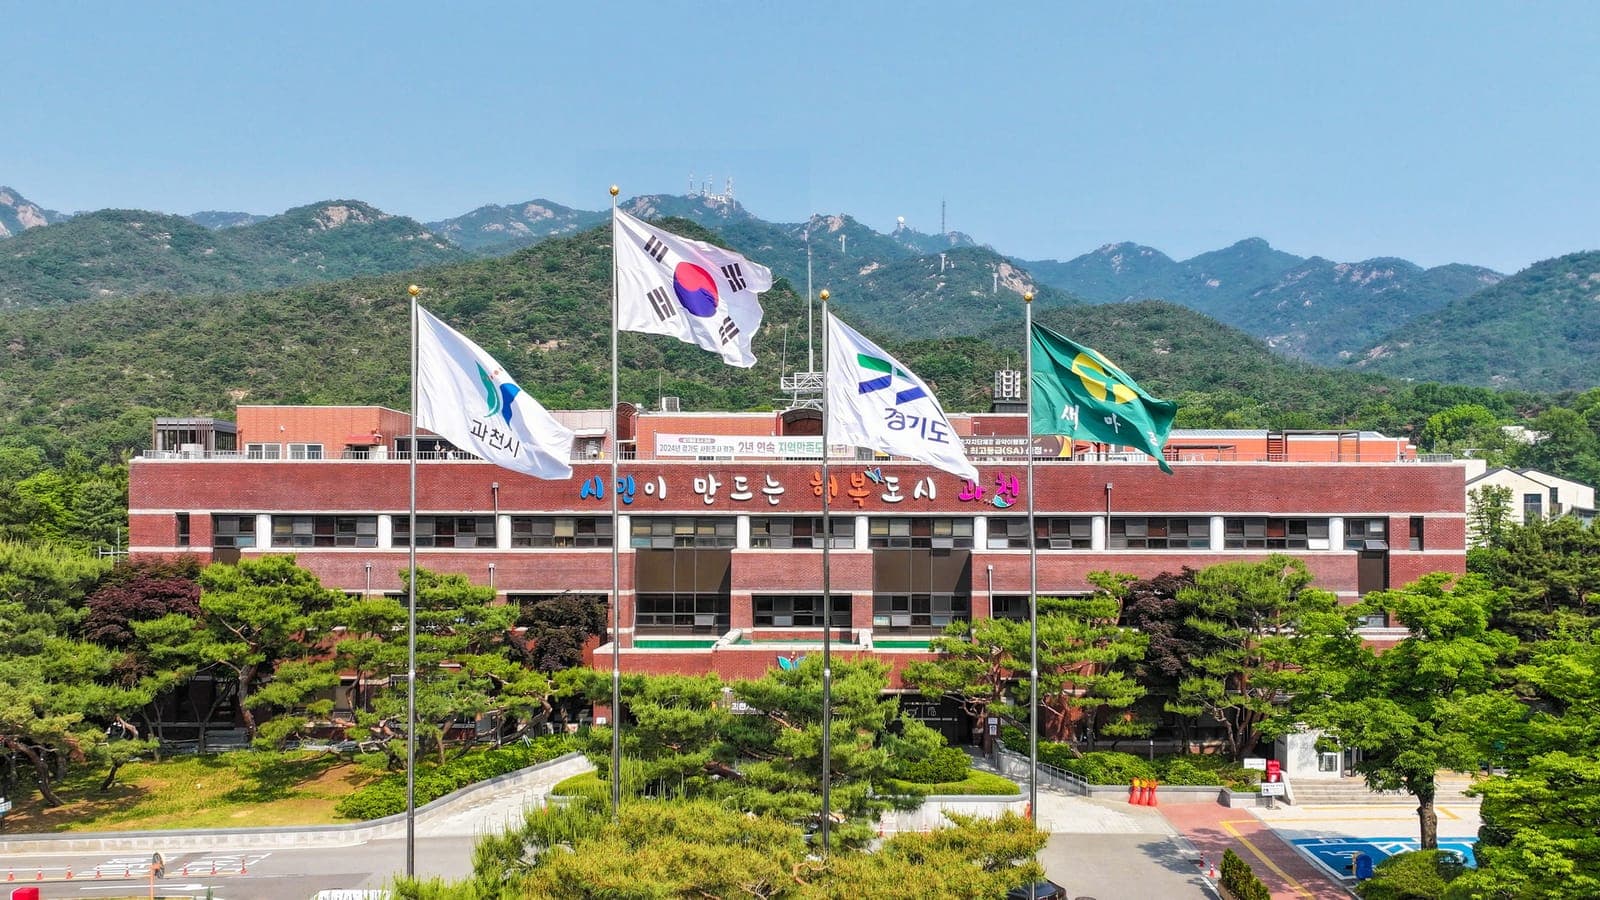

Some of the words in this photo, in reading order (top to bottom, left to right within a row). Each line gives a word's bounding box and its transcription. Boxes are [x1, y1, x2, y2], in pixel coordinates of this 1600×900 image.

[470, 419, 520, 457] 과천시
[884, 407, 949, 444] 경기도
[738, 441, 754, 453] 2년
[756, 442, 776, 454] 연속
[580, 474, 667, 504] 시민이
[693, 473, 785, 504] 만드는
[958, 471, 1020, 507] 과천
